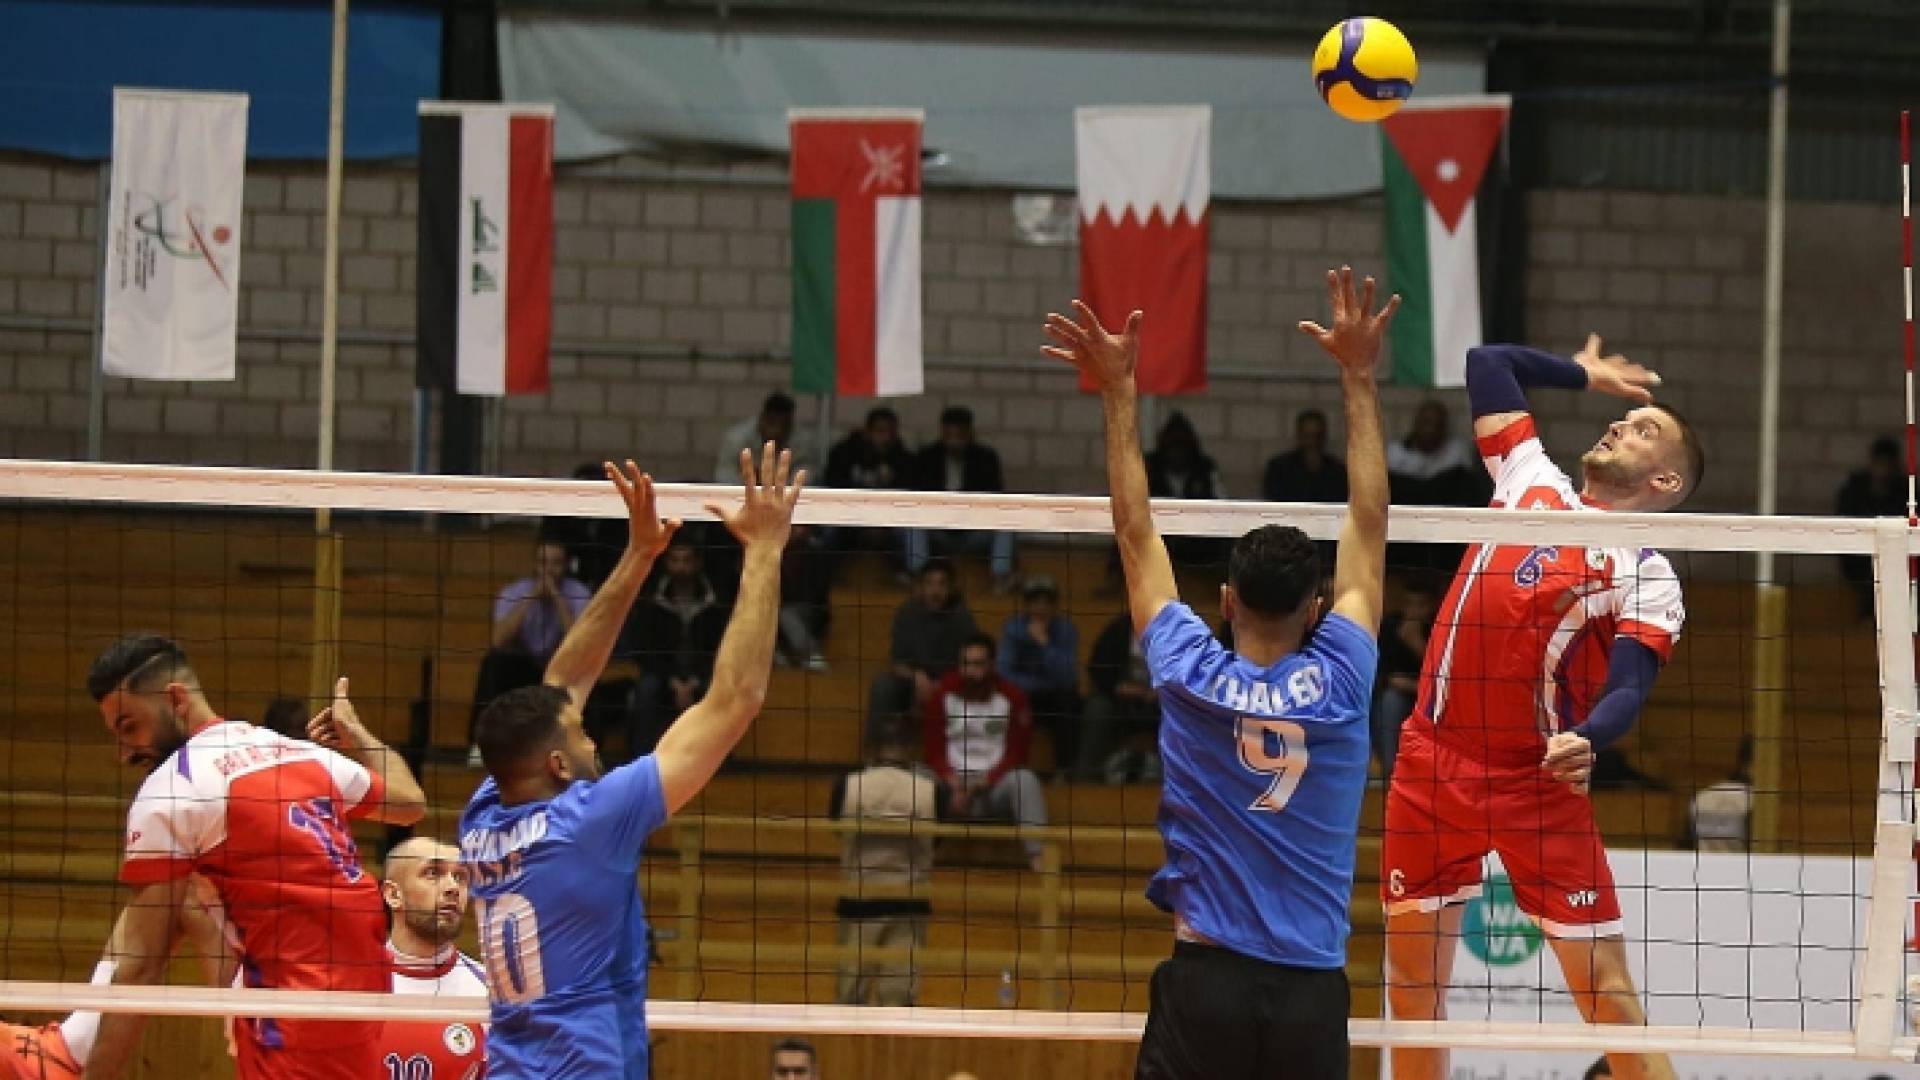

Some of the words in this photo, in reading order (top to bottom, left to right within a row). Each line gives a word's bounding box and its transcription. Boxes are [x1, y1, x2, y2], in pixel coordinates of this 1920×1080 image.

[1512, 546, 1559, 587] 6
[1234, 715, 1311, 813] 9
[1390, 869, 1405, 896] 6
